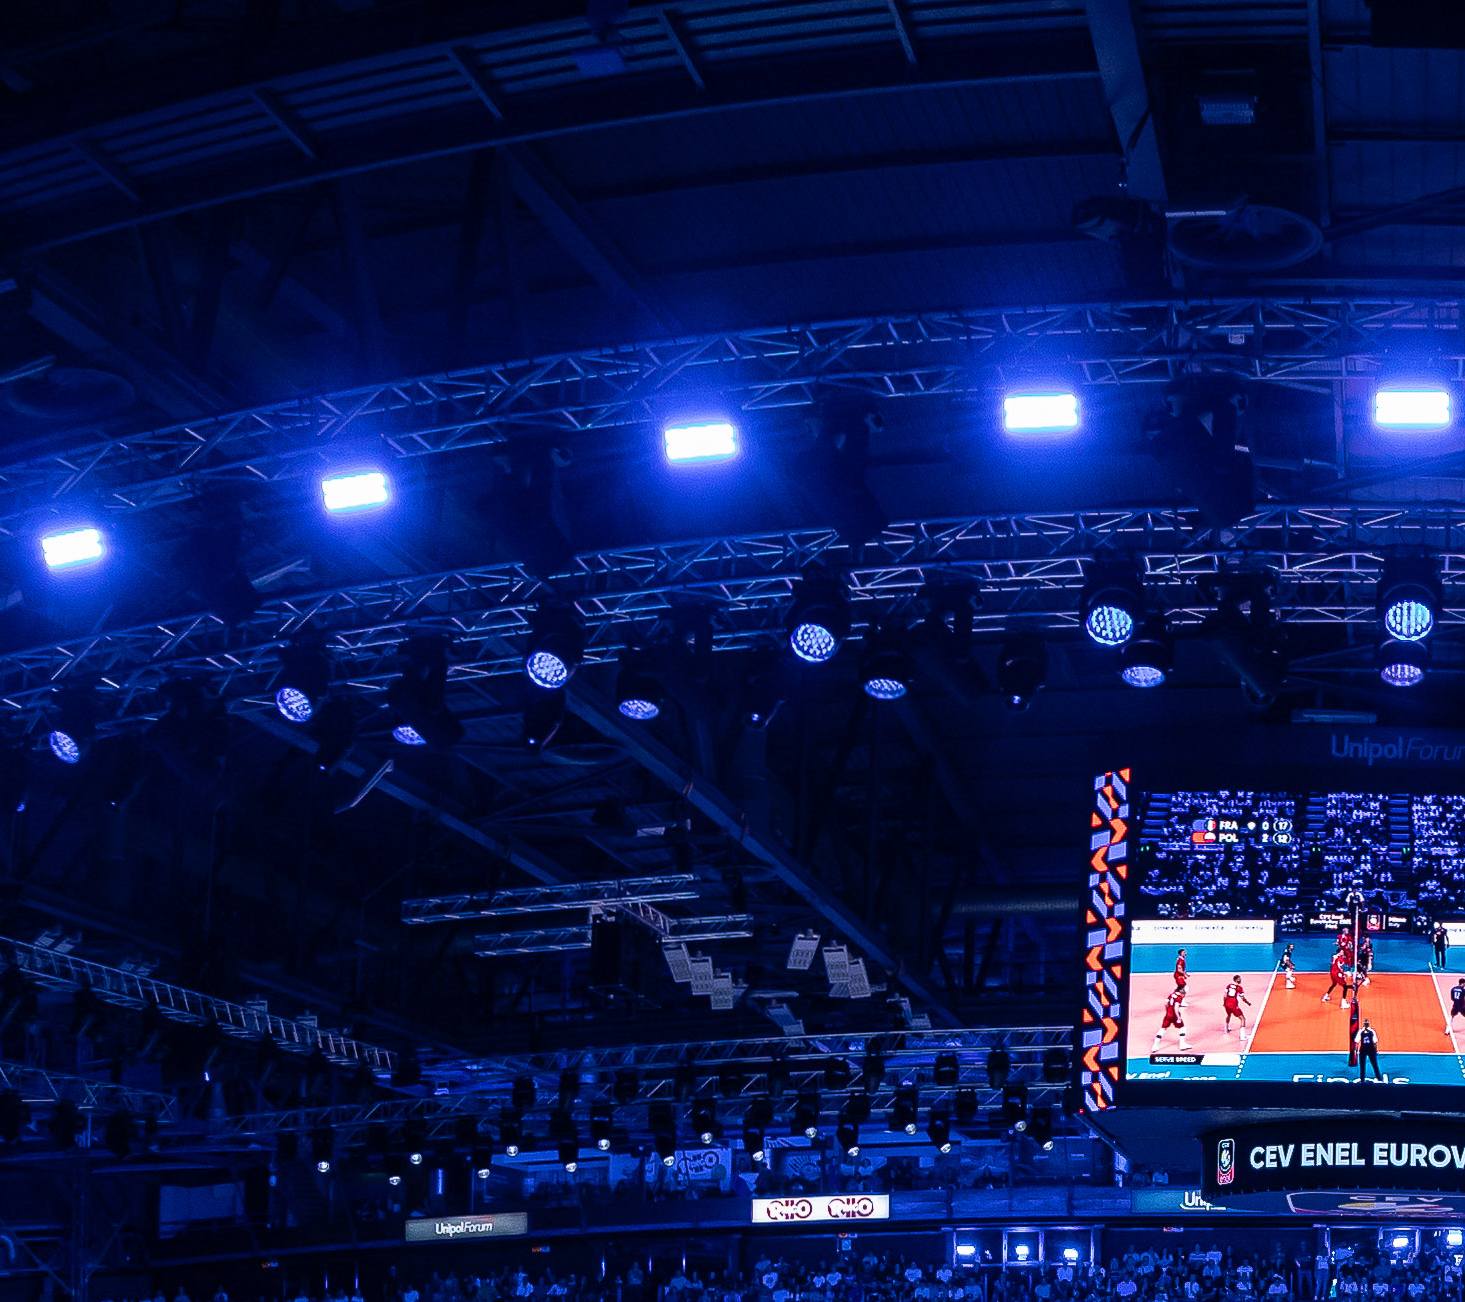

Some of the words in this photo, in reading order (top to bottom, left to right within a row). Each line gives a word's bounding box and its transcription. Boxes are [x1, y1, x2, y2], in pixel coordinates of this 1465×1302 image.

[1219, 820, 1238, 830] FRA
[1262, 821, 1269, 830] 0
[1219, 833, 1239, 843] POL
[1262, 833, 1269, 843] 2
[1250, 1144, 1295, 1169] CEV
[1301, 1142, 1365, 1166] ENEL
[435, 1222, 493, 1237] UnipolForum
